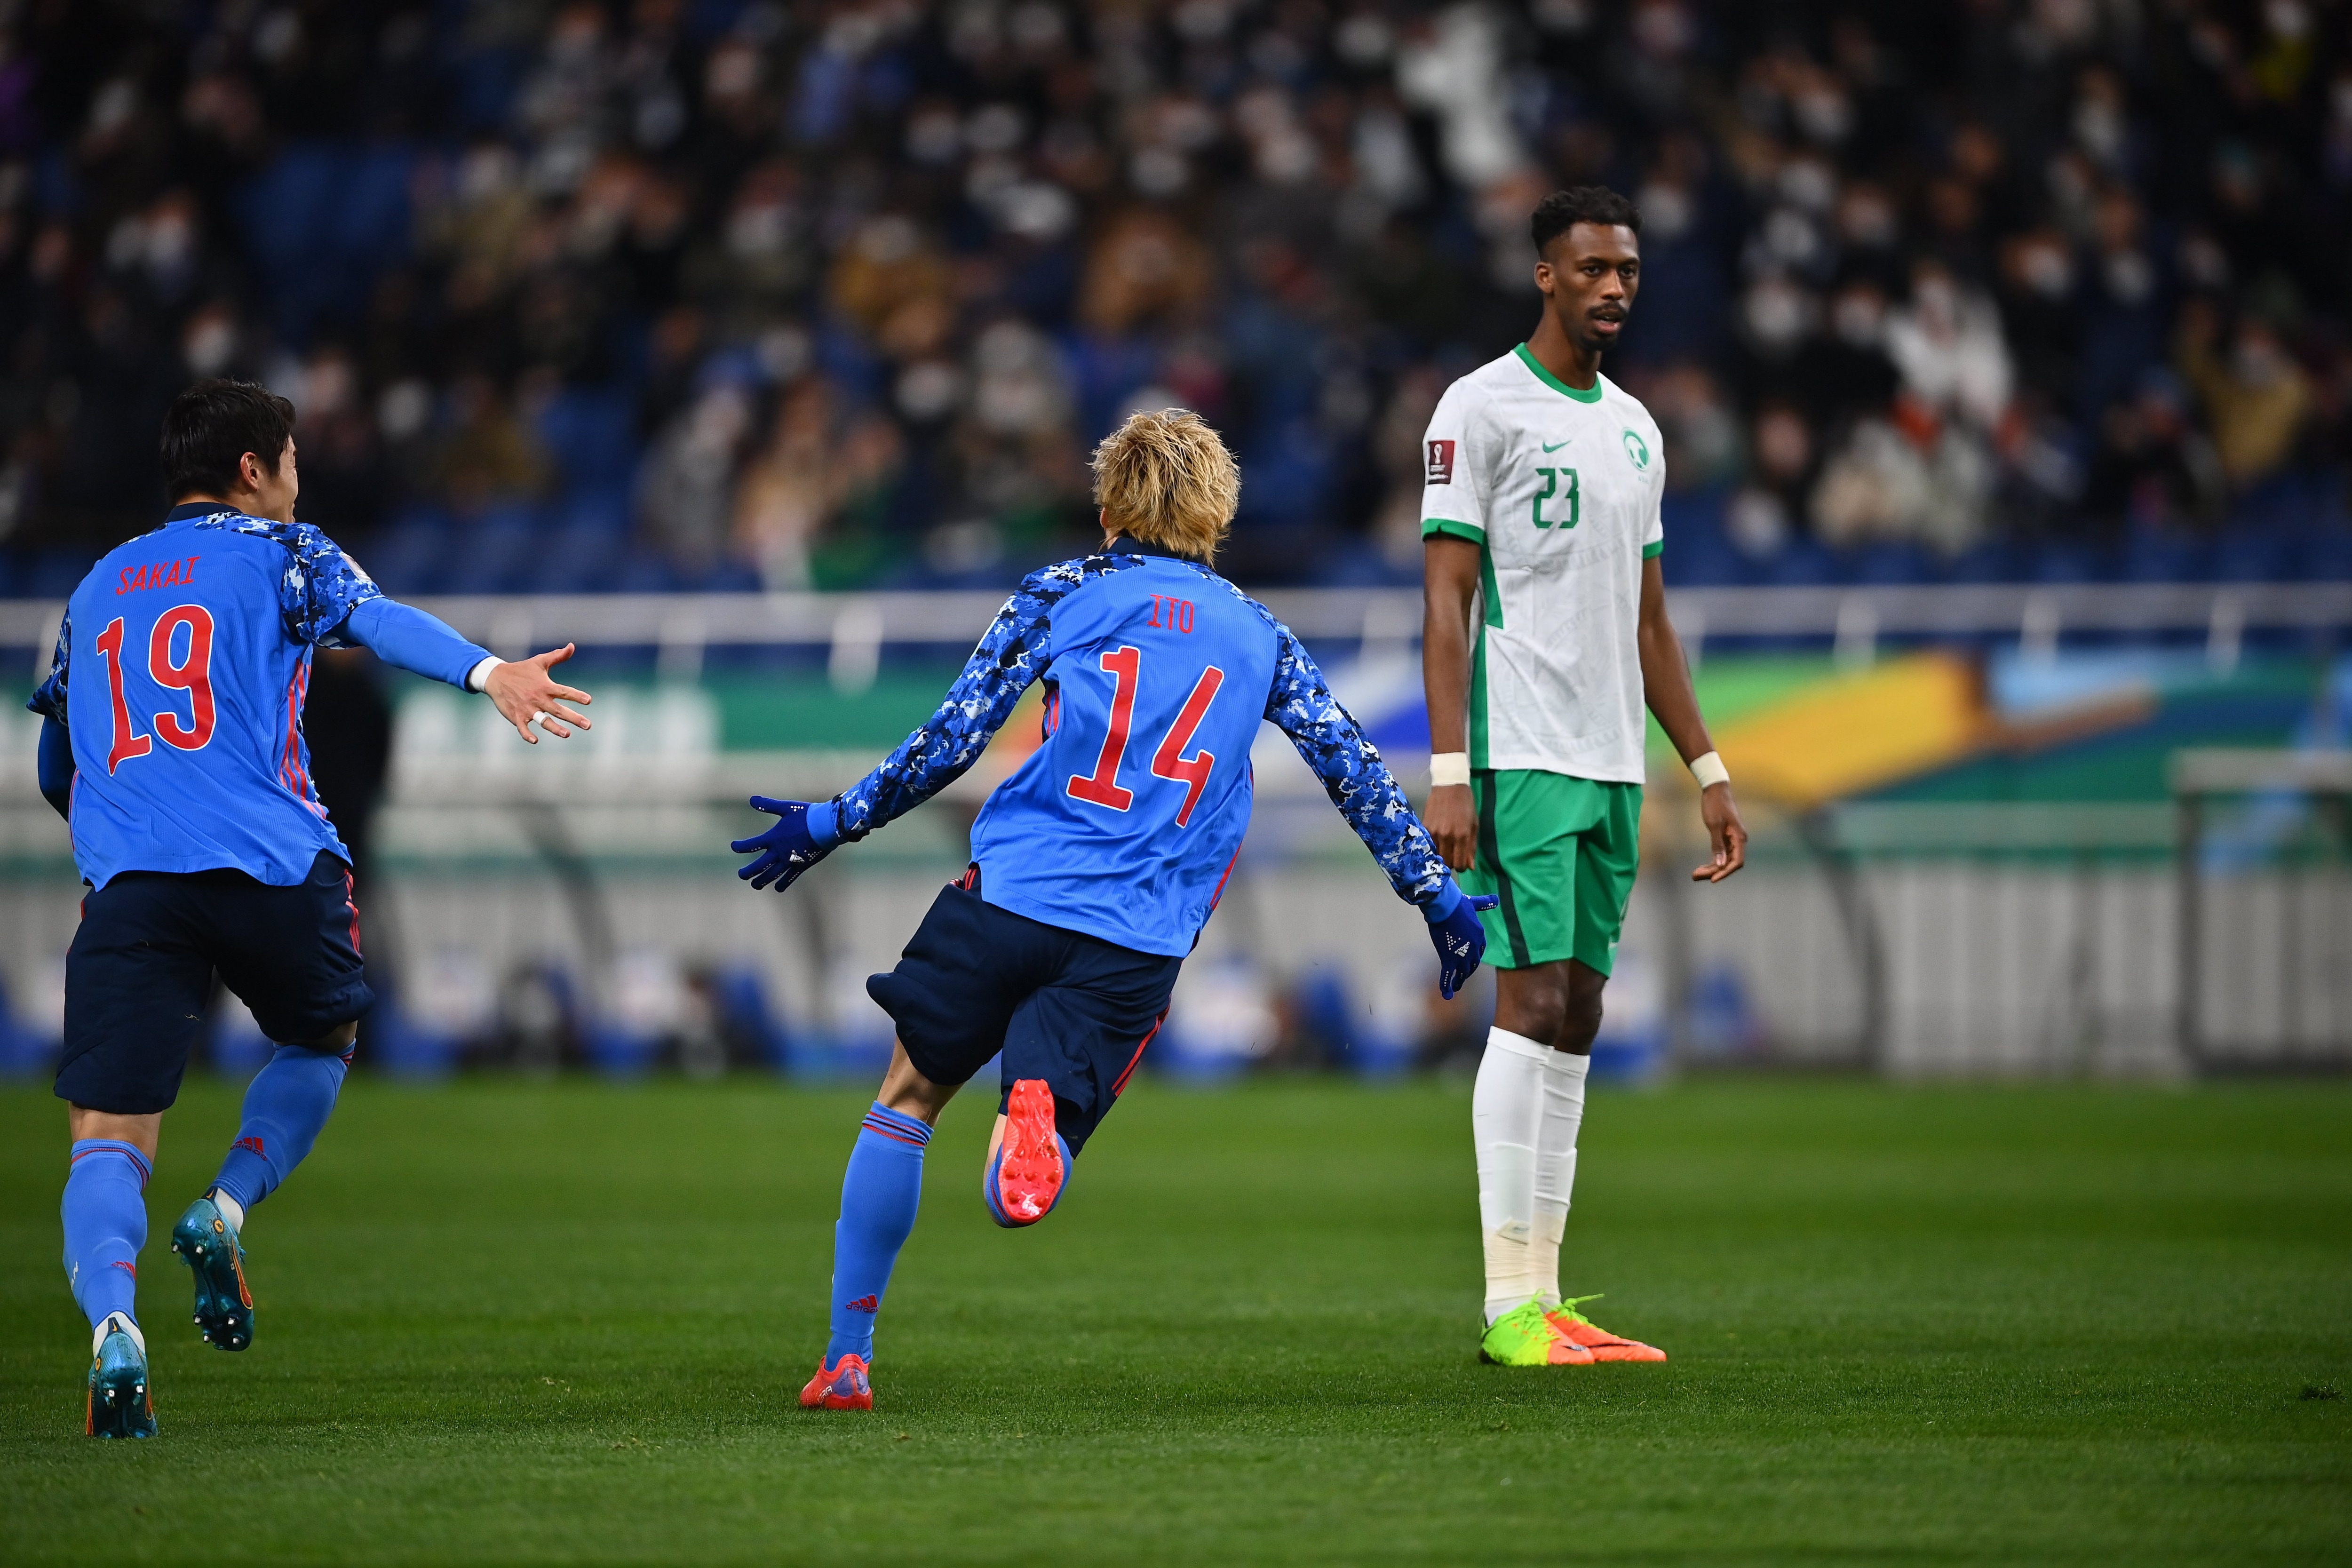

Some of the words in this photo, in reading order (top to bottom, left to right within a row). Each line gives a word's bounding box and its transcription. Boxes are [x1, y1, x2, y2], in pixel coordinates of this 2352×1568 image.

[1533, 467, 1579, 528] 23
[116, 556, 200, 596] SAKAI
[1147, 594, 1194, 634] ITO
[96, 604, 217, 777] 19
[1066, 645, 1224, 828] 14
[230, 1144, 267, 1162] adidas
[846, 1304, 879, 1313] adidas
[817, 1385, 833, 1405] LTRA
